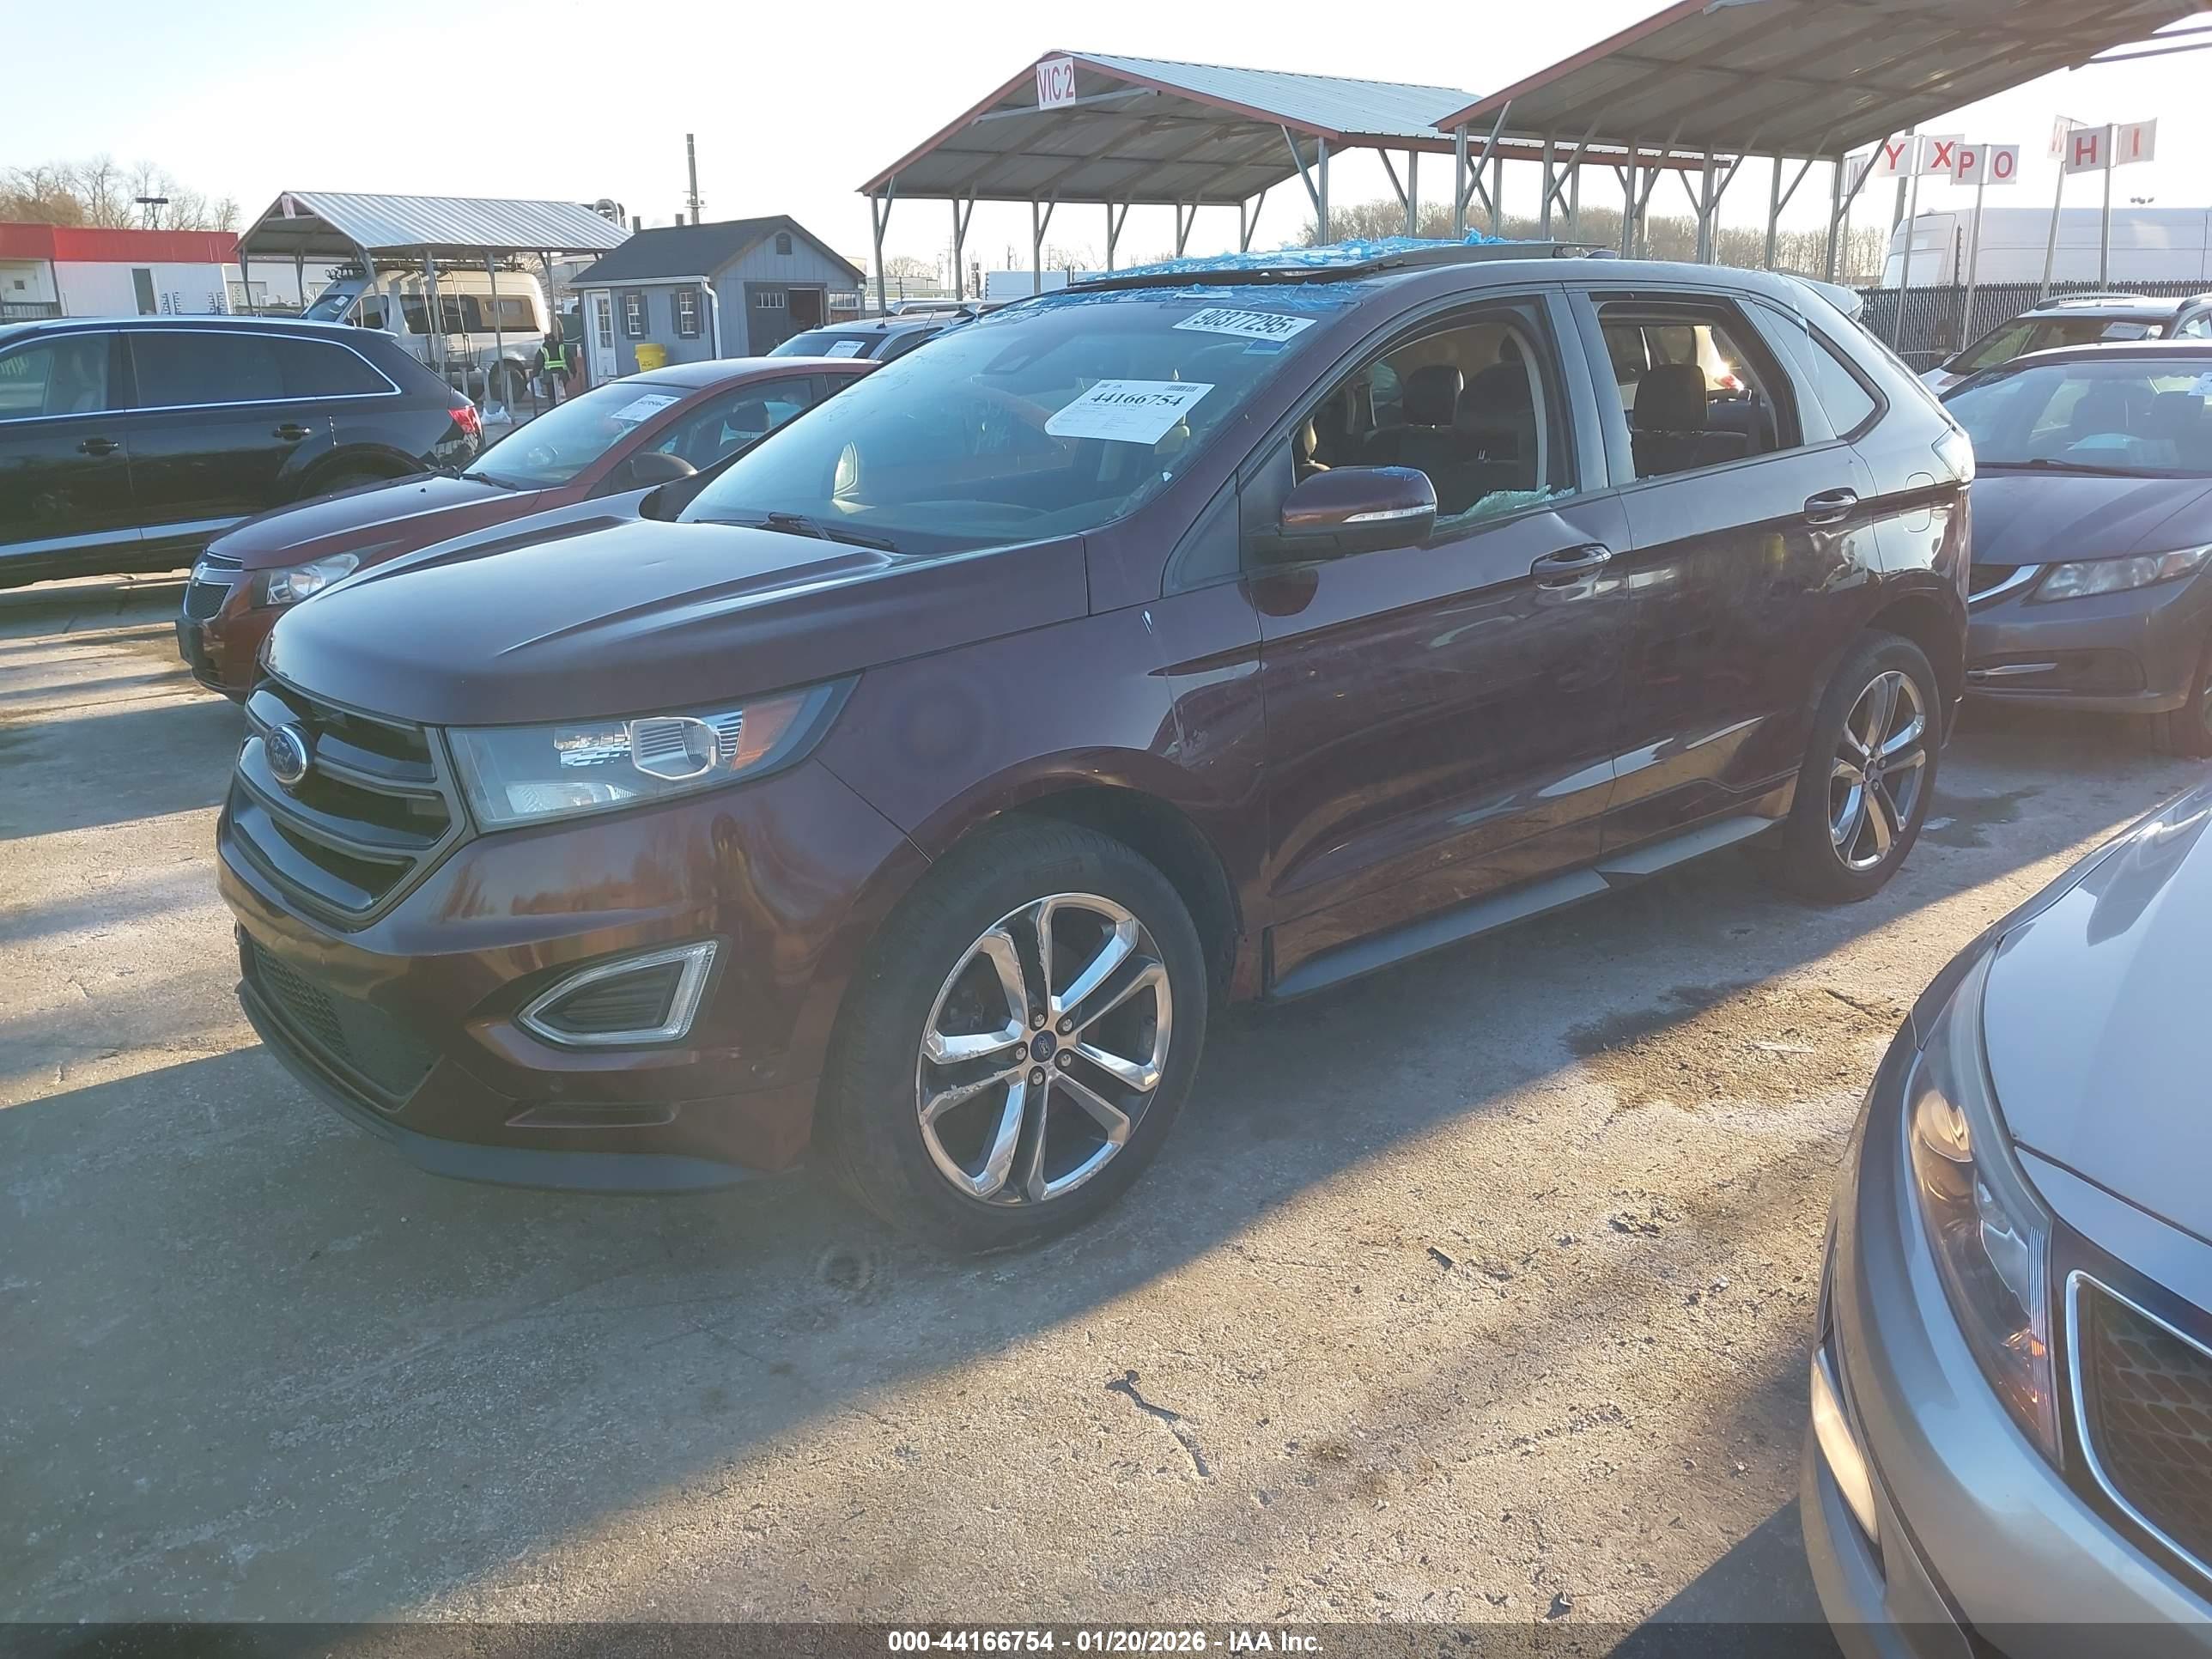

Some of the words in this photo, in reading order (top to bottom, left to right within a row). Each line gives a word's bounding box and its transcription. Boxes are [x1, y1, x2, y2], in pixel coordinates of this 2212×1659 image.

[1037, 66, 1061, 102] VIC
[1064, 64, 1074, 98] 2
[1930, 141, 1955, 168] X
[2075, 135, 2097, 166] H
[2132, 127, 2141, 157] I
[1886, 143, 1905, 170] Y
[1958, 151, 1976, 179] P
[1091, 392, 1186, 407] 44166754
